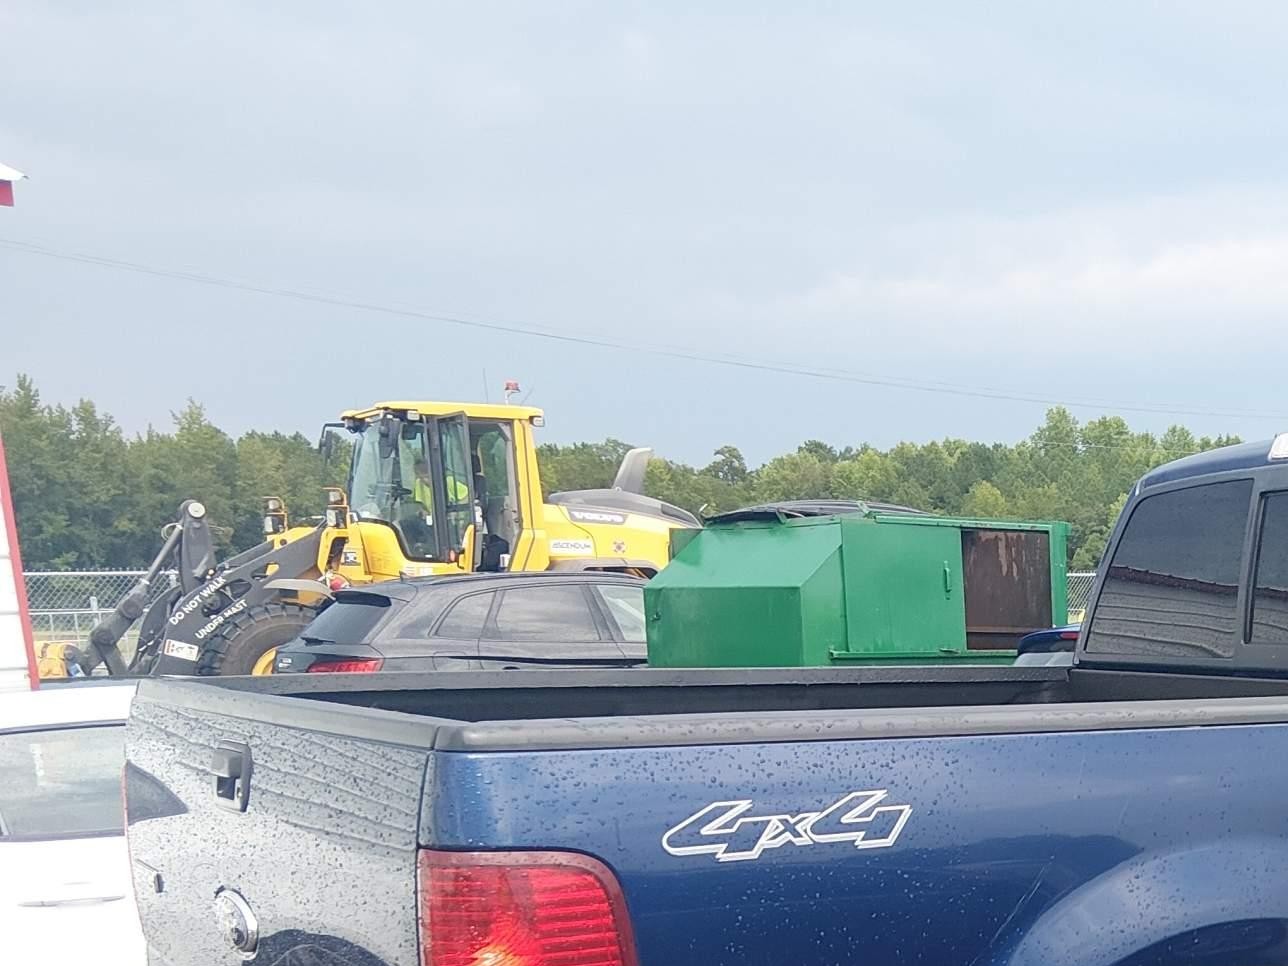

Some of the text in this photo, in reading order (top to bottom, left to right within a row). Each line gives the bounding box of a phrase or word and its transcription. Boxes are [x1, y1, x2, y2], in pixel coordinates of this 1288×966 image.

[169, 575, 227, 626] DO NOT WALK
[194, 599, 248, 639] UNDER MAST
